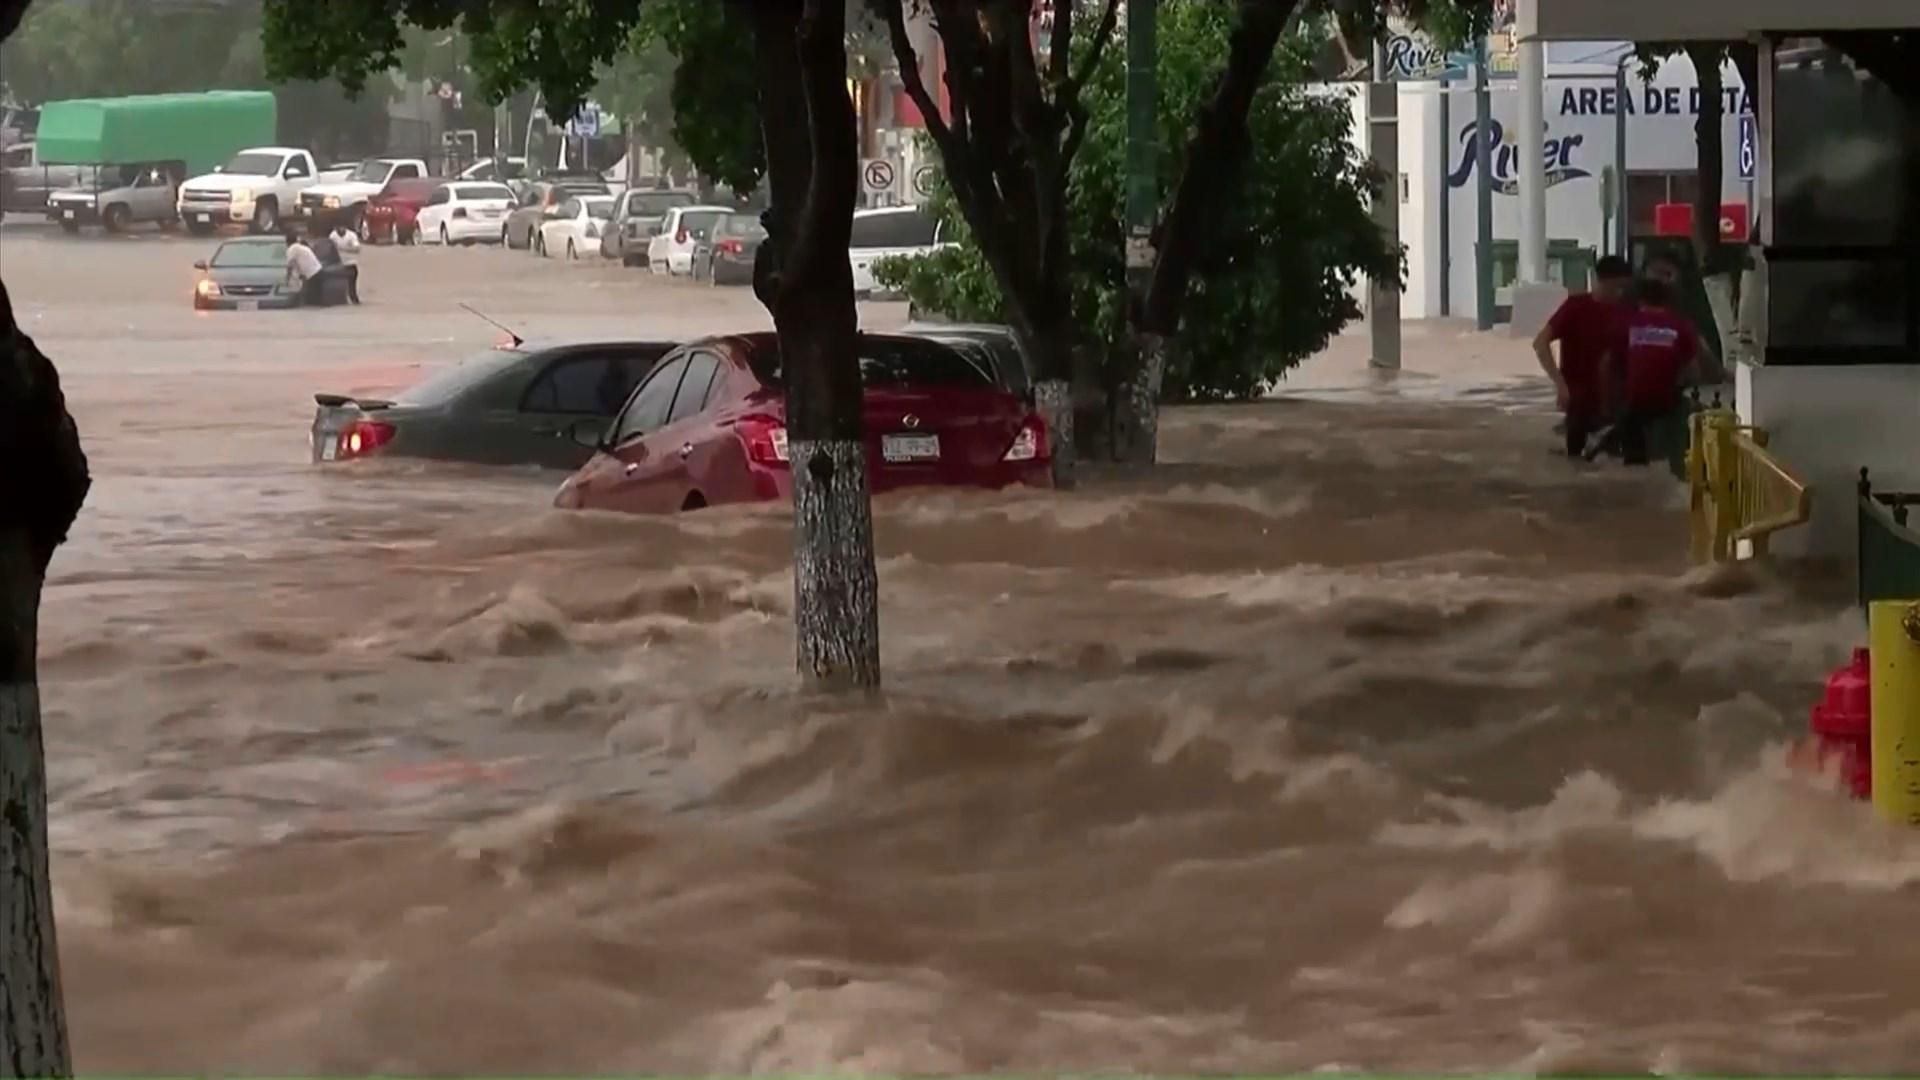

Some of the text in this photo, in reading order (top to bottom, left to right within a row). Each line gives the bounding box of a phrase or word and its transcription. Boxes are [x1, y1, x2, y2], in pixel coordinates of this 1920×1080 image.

[1560, 87, 1757, 115] AREA DE DTA
[1448, 119, 1583, 187] Rier
